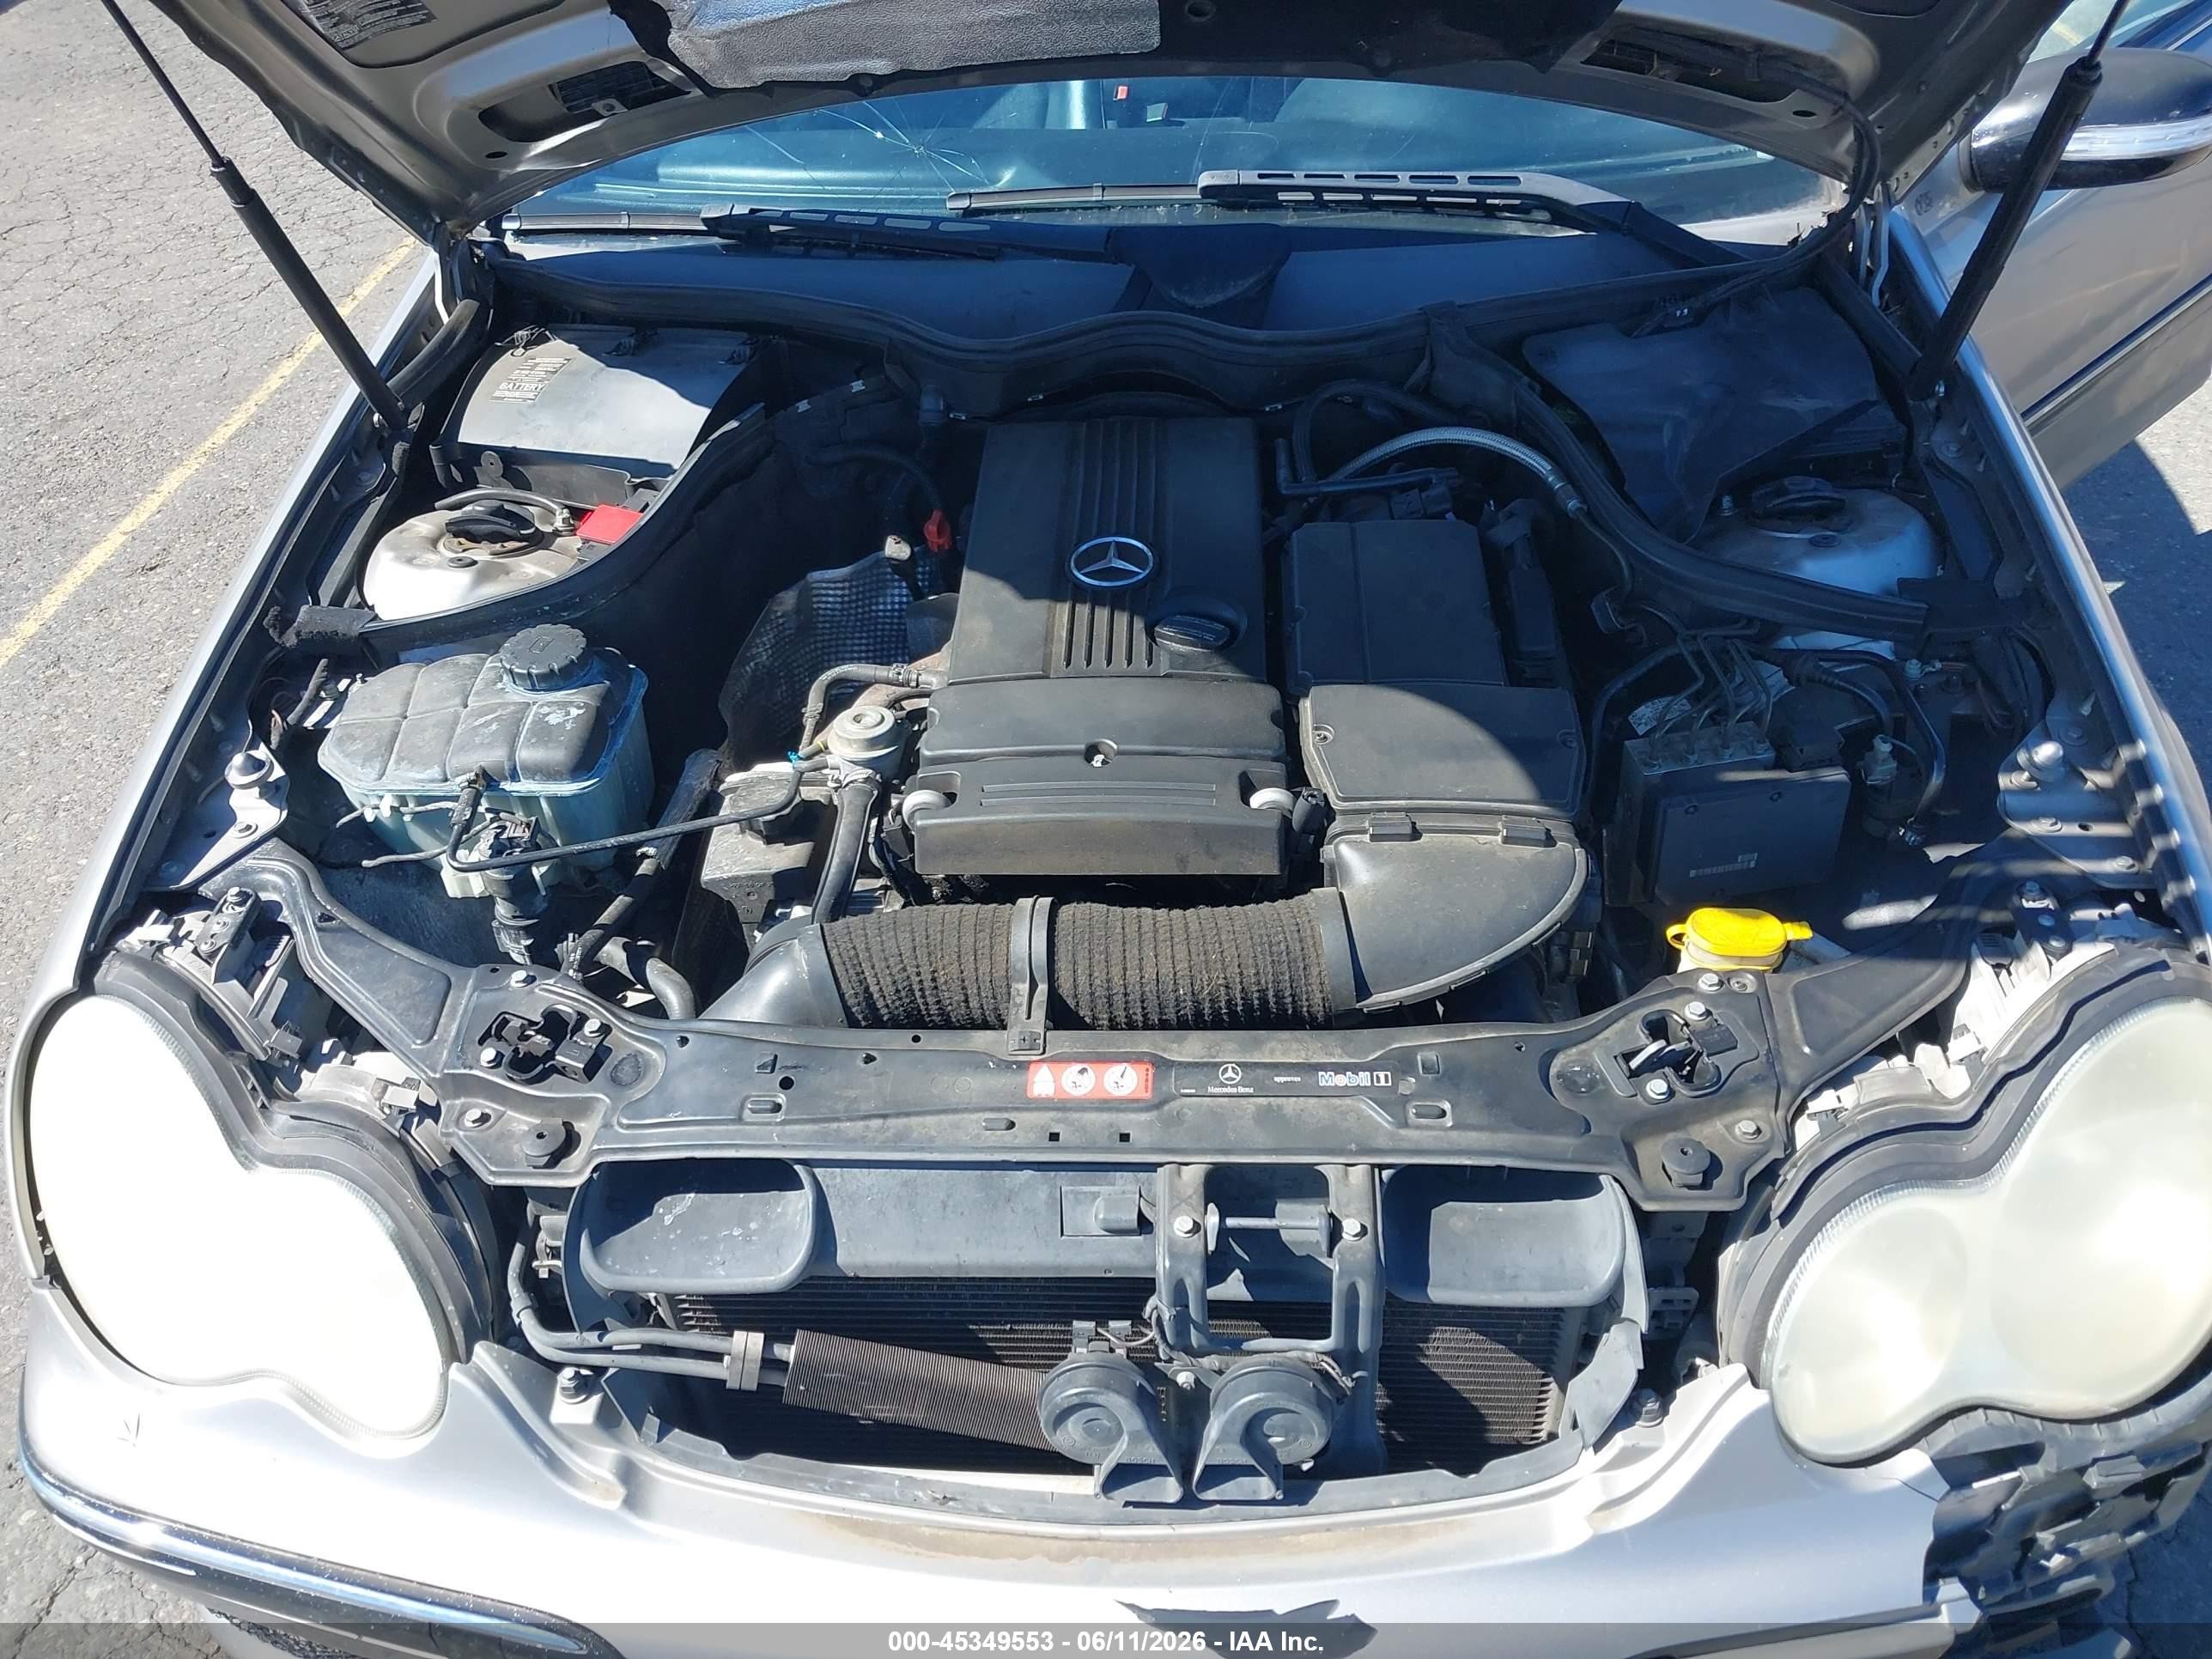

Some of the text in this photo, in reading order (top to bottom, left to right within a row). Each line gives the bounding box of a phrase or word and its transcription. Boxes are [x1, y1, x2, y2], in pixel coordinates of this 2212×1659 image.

[499, 382, 545, 392] BATTERY
[1319, 1072, 1392, 1086] Mobil 1
